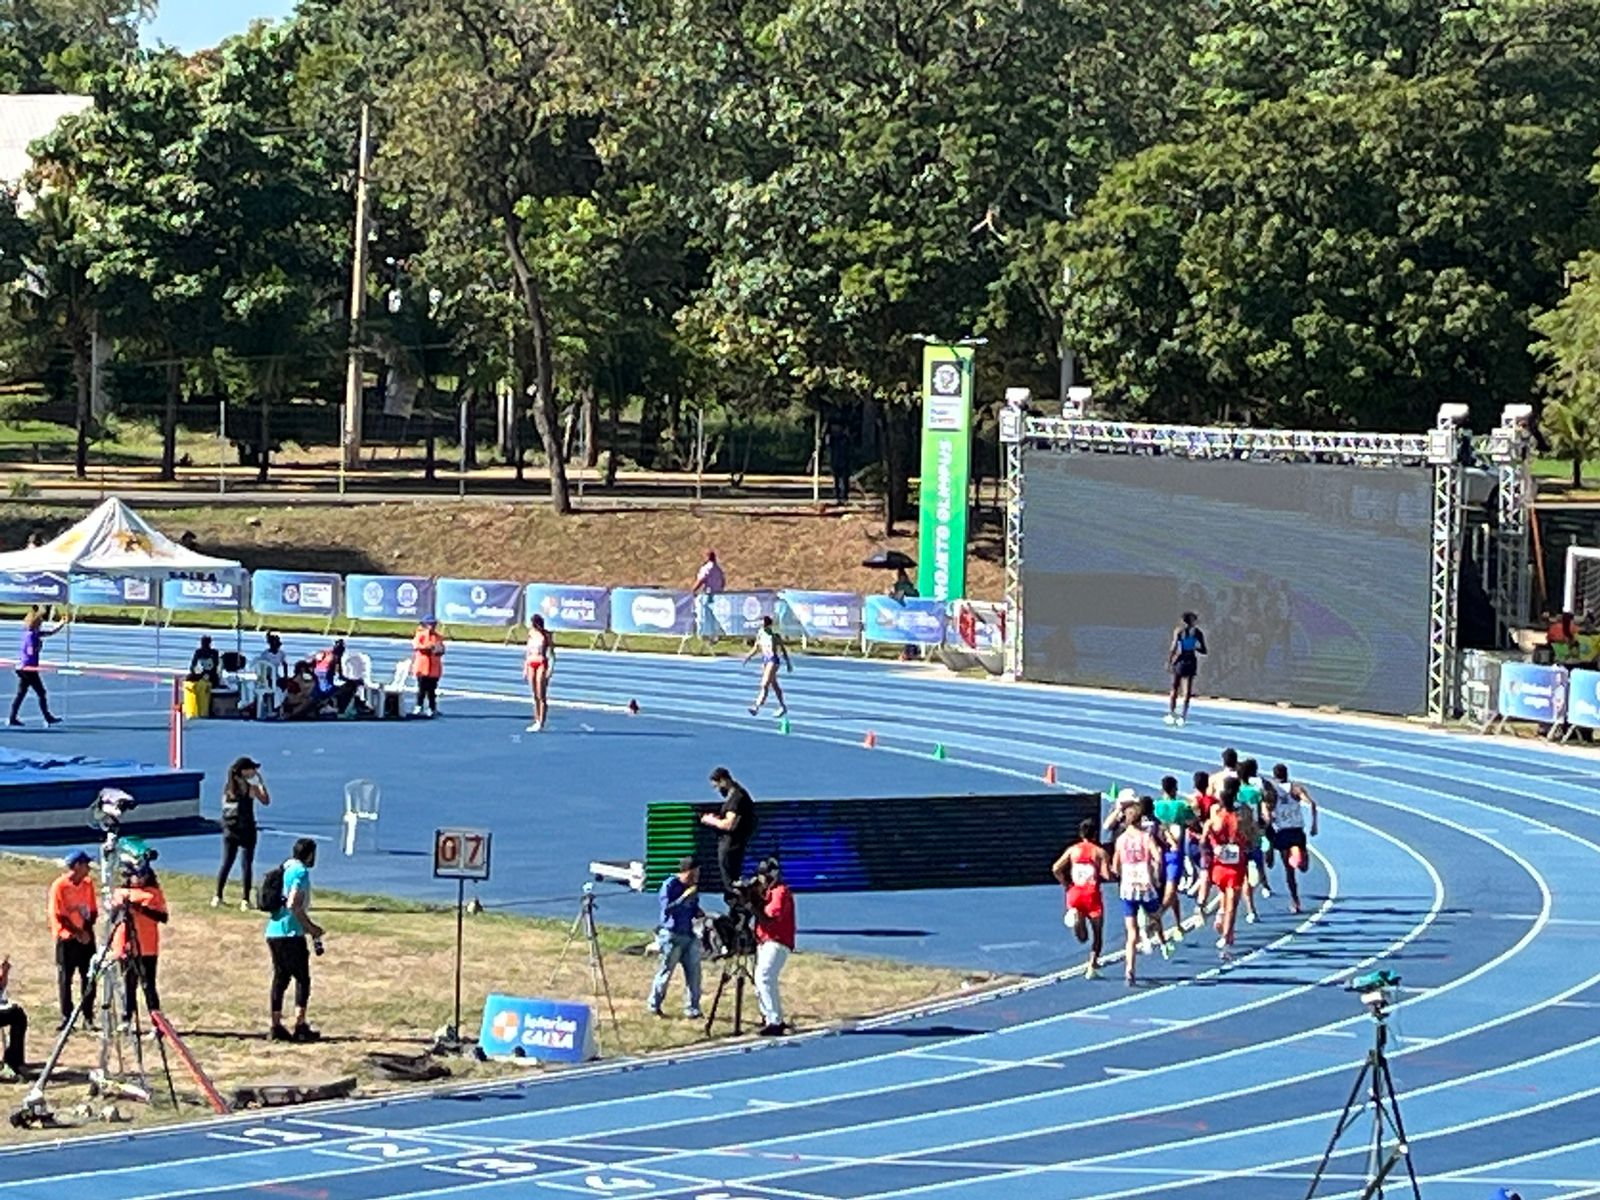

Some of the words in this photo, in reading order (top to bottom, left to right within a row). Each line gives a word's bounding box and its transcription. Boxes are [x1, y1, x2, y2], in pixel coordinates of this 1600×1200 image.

[441, 835, 482, 864] 07
[521, 1030, 574, 1049] CAIXA
[346, 1142, 431, 1158] 2
[456, 1158, 537, 1173] 3
